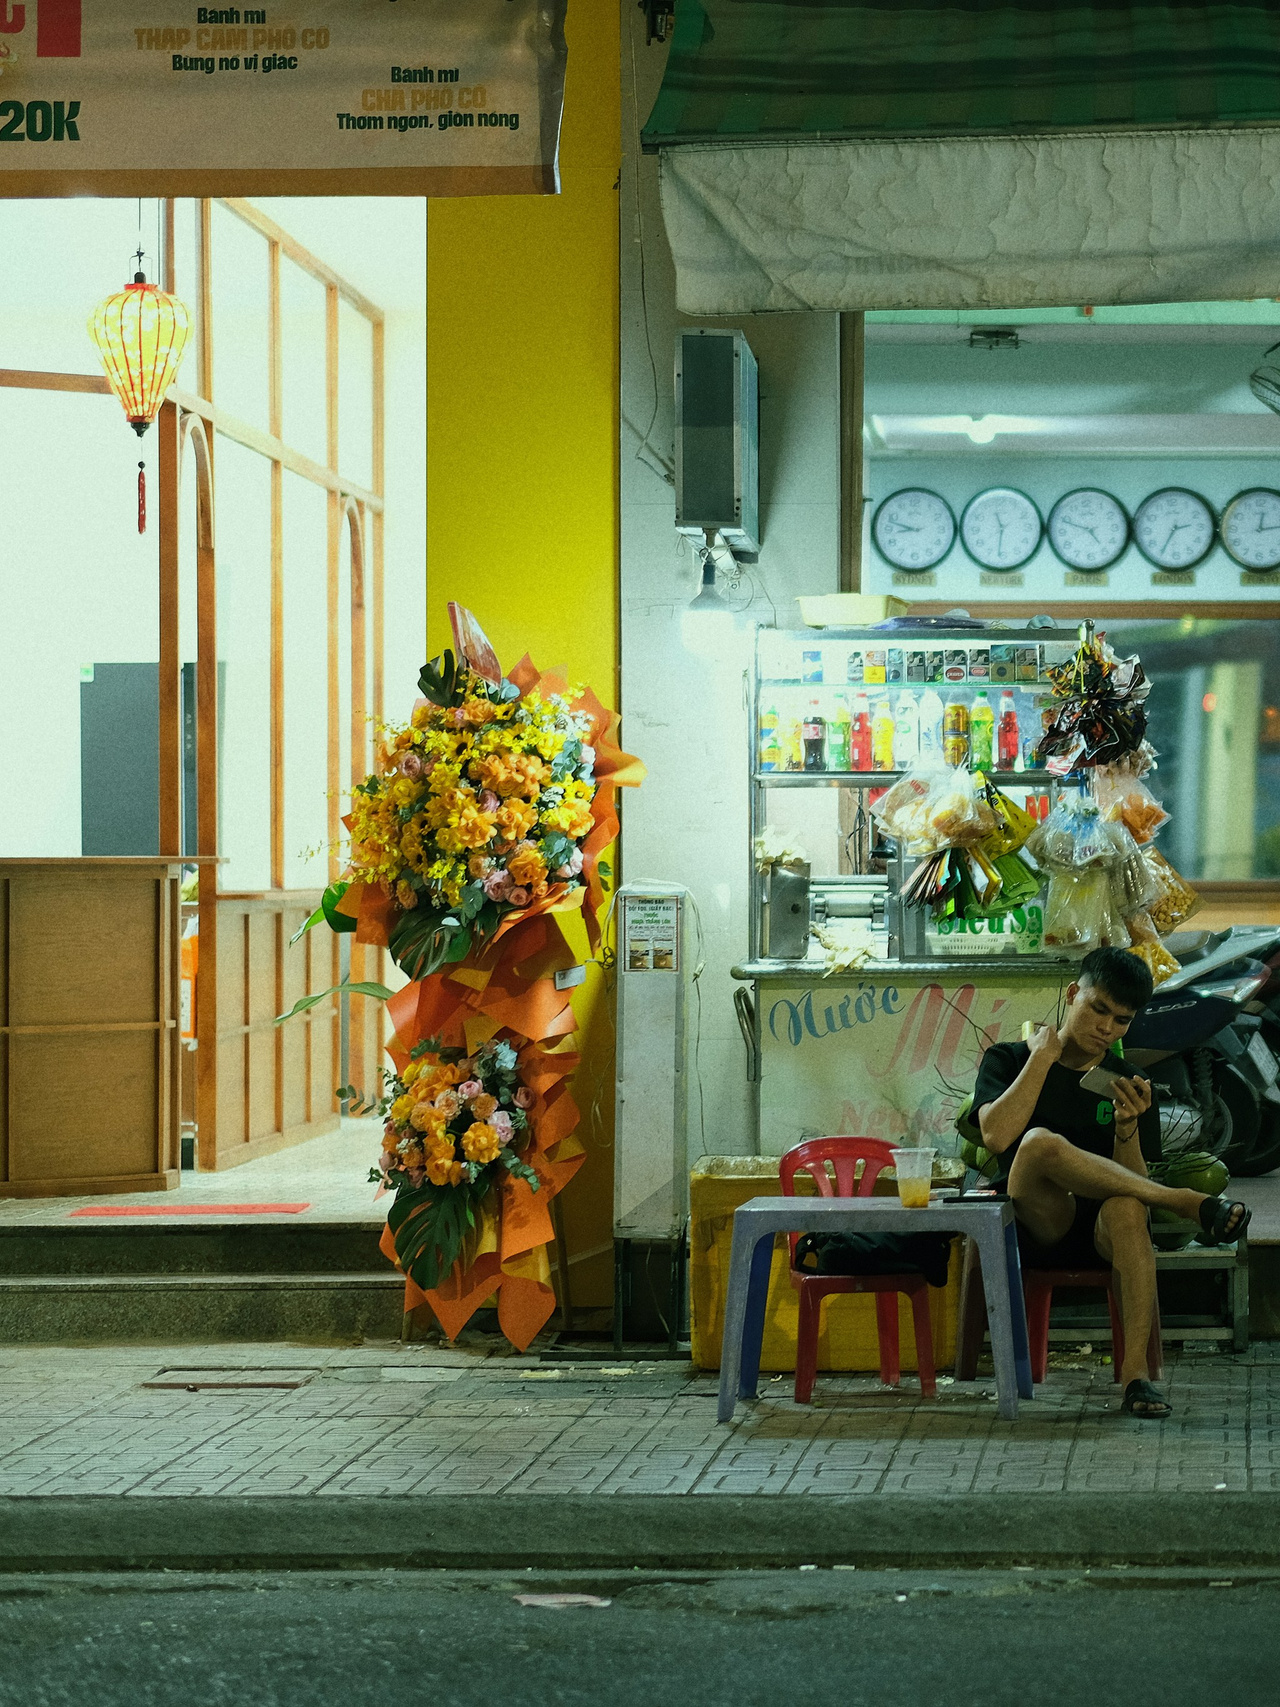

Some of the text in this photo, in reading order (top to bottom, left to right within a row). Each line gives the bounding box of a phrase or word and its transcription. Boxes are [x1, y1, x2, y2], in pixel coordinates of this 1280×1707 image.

[0, 100, 81, 142] 20K
[388, 115, 434, 132] ngon,
[894, 573, 934, 585] SYDNEY
[1072, 574, 1102, 586] PARIS
[768, 982, 1011, 1078] Nước Mí
